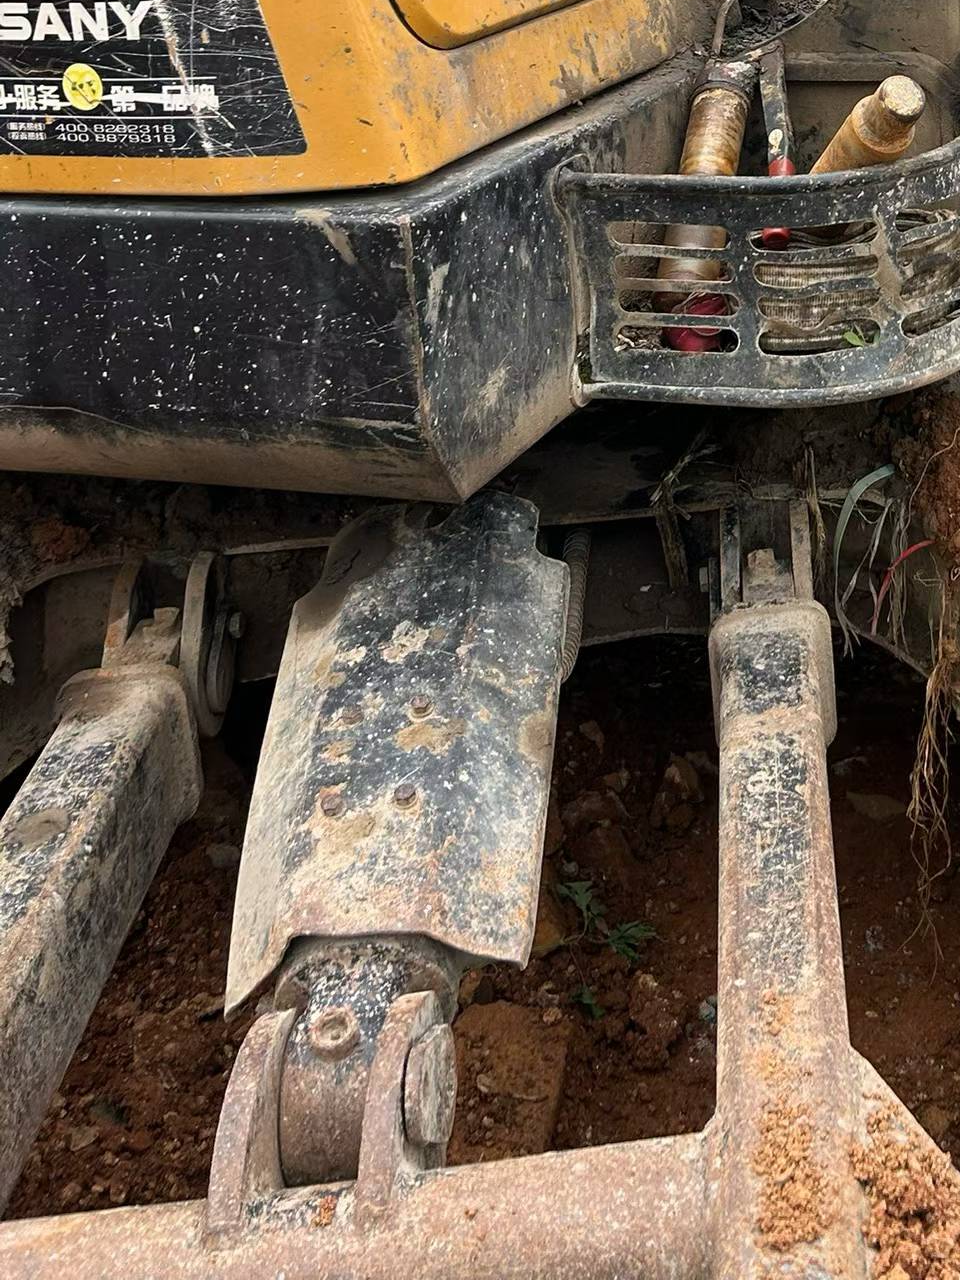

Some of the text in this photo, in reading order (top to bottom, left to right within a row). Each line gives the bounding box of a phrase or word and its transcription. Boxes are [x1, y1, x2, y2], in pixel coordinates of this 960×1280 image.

[0, 1, 151, 41] SANY
[0, 84, 61, 111] 服务
[55, 123, 88, 133] 400
[93, 124, 175, 134] 8282318
[56, 132, 89, 143] 400
[95, 133, 176, 144] 8879318
